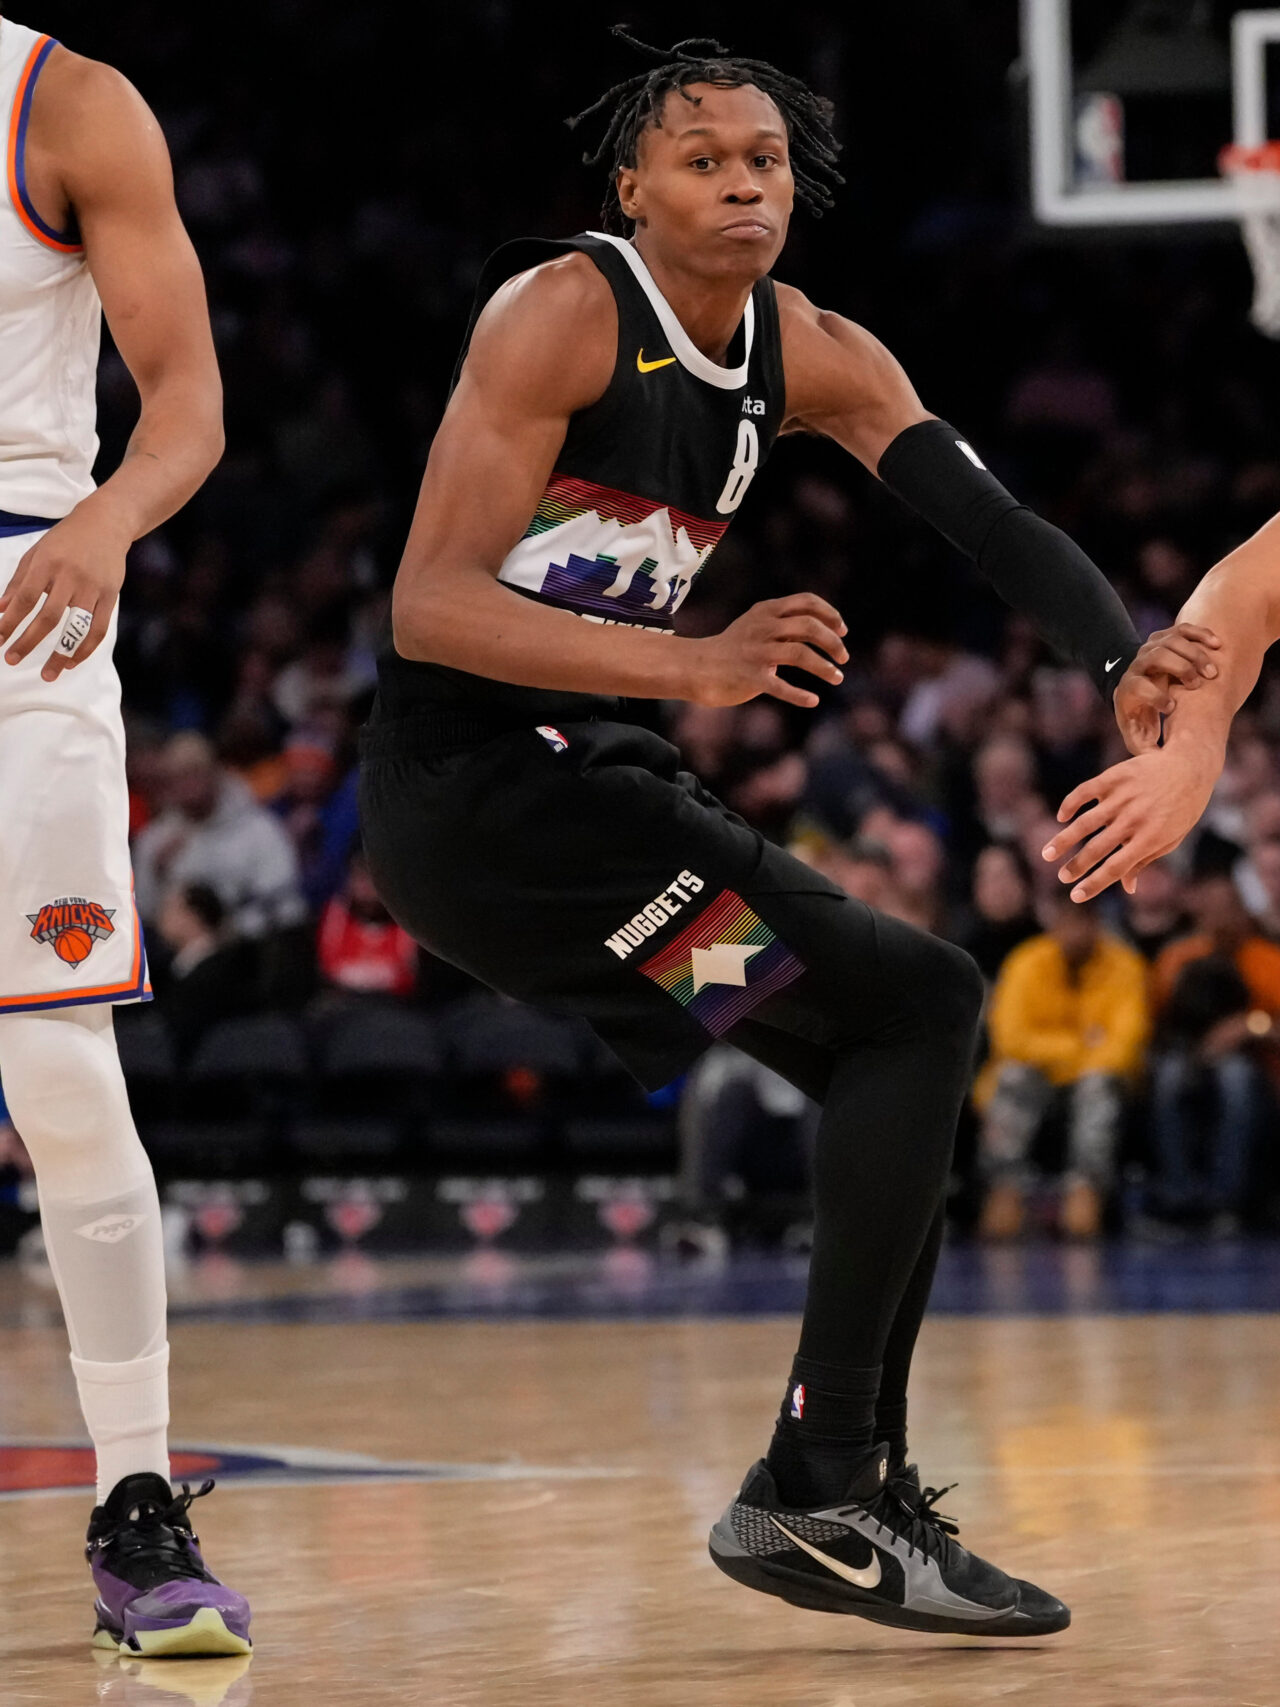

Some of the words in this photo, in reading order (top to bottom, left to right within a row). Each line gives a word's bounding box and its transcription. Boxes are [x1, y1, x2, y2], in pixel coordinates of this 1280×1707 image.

[715, 418, 759, 514] 8
[30, 902, 115, 942] KNICKS
[604, 869, 705, 961] NUGGETS
